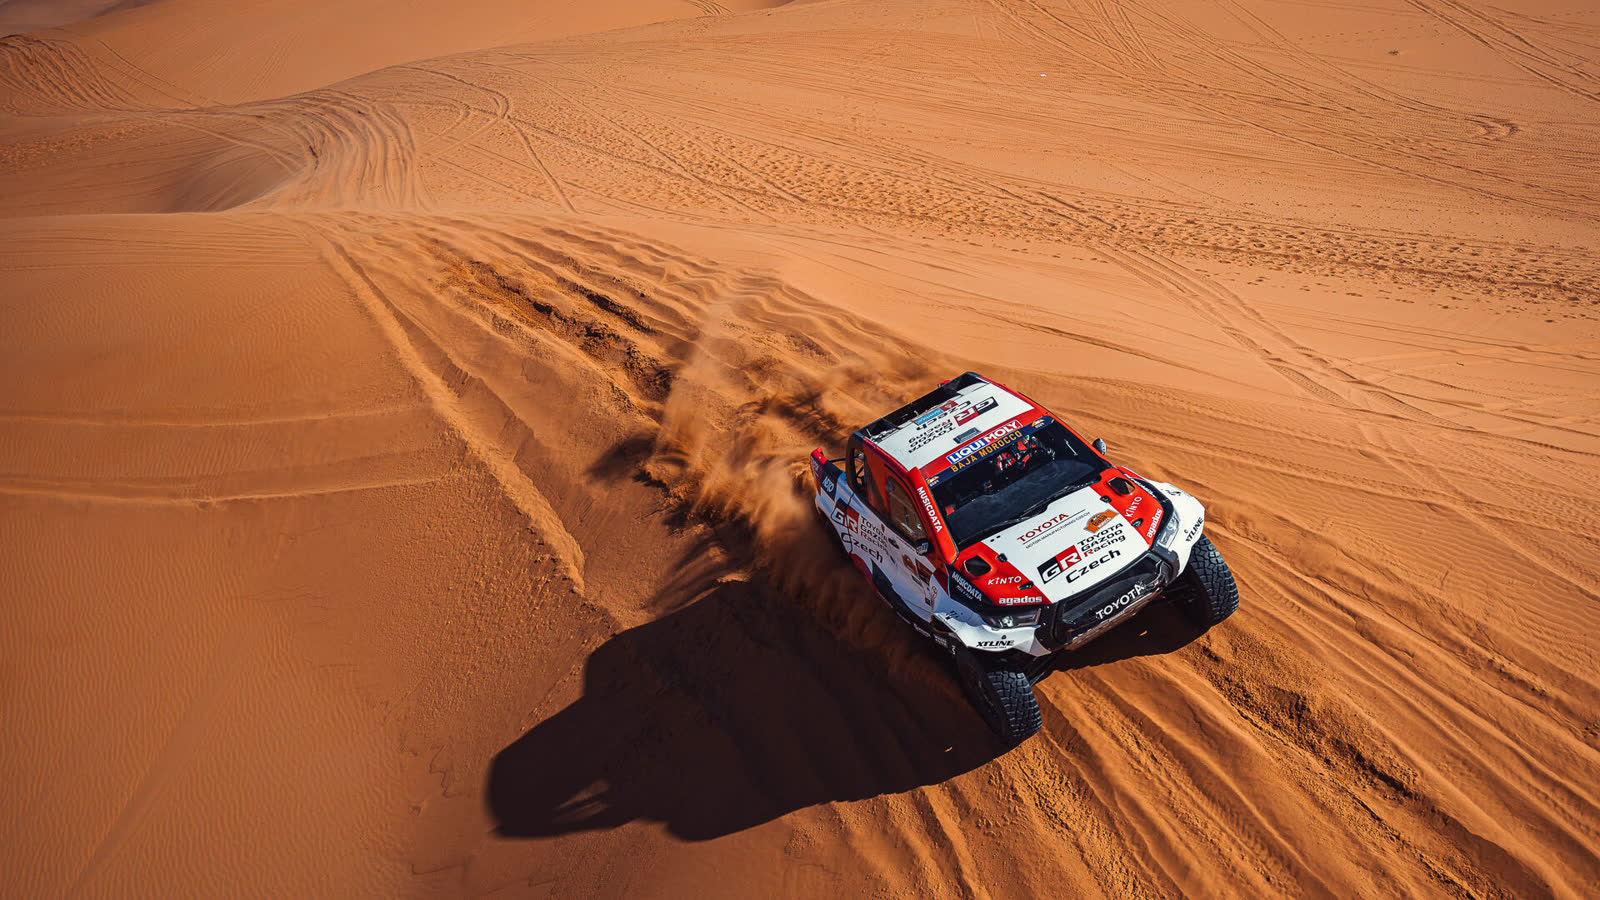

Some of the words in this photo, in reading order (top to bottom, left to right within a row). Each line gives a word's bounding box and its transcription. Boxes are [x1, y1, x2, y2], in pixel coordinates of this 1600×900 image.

[916, 400, 972, 431] Czech
[954, 397, 998, 425] GR
[908, 419, 951, 444] Racing
[908, 426, 956, 453] TOYOTA
[910, 421, 953, 447] GAZOO
[949, 439, 985, 464] LIQUI
[984, 420, 1021, 443] MOLY
[951, 456, 978, 473] BAJA
[979, 430, 1023, 457] MOROCCO
[831, 502, 859, 534] GR
[917, 486, 943, 533] MUSICDATA
[1146, 508, 1163, 539] agados
[1017, 513, 1069, 542] TOYOTA
[1077, 522, 1123, 546] TOYOTA
[1080, 529, 1123, 552] GAZOO
[841, 532, 884, 564] Czech
[1083, 535, 1126, 557] Racing
[1038, 546, 1082, 584] GR
[1065, 549, 1121, 584] Czech
[951, 571, 983, 602] MUSICDATA
[998, 595, 1043, 606] agados
[1095, 583, 1145, 620] TOYOTA
[976, 640, 1015, 648] XTLINE
